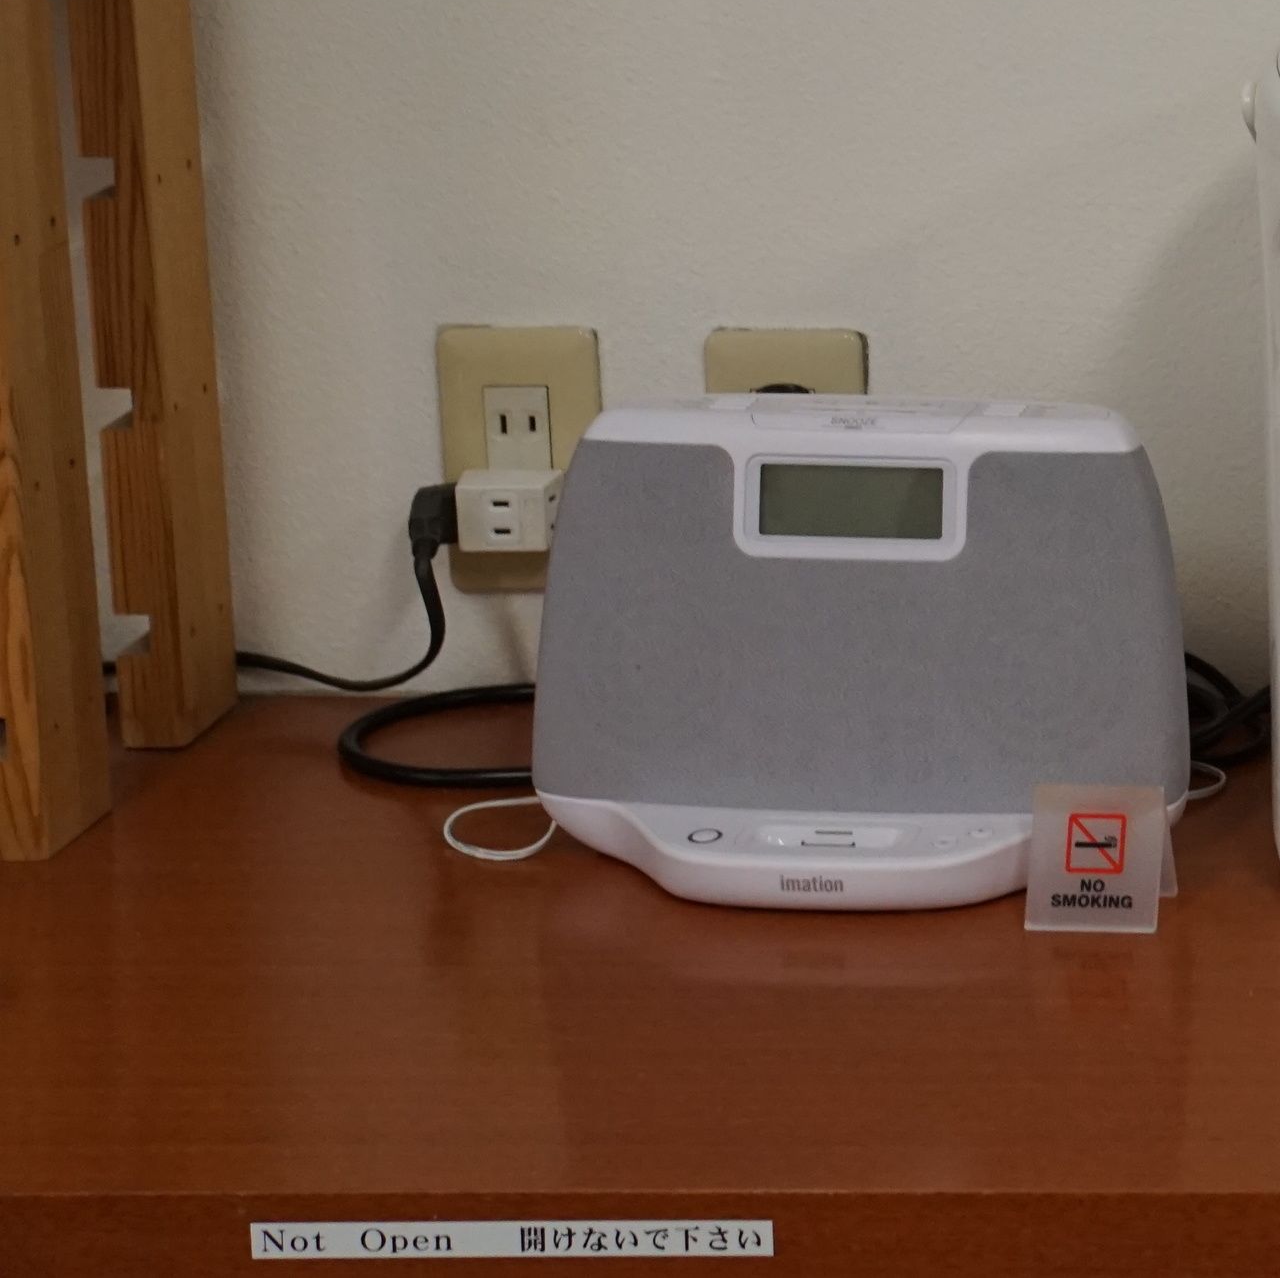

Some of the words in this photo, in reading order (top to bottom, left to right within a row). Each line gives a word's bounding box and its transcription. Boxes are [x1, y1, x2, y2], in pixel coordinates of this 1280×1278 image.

[780, 874, 845, 893] imation
[1080, 879, 1106, 892] NO
[1050, 894, 1133, 910] SMOKING
[261, 1229, 325, 1253] Not
[360, 1228, 454, 1256] Open
[520, 1226, 763, 1253] 開けないで下さい
